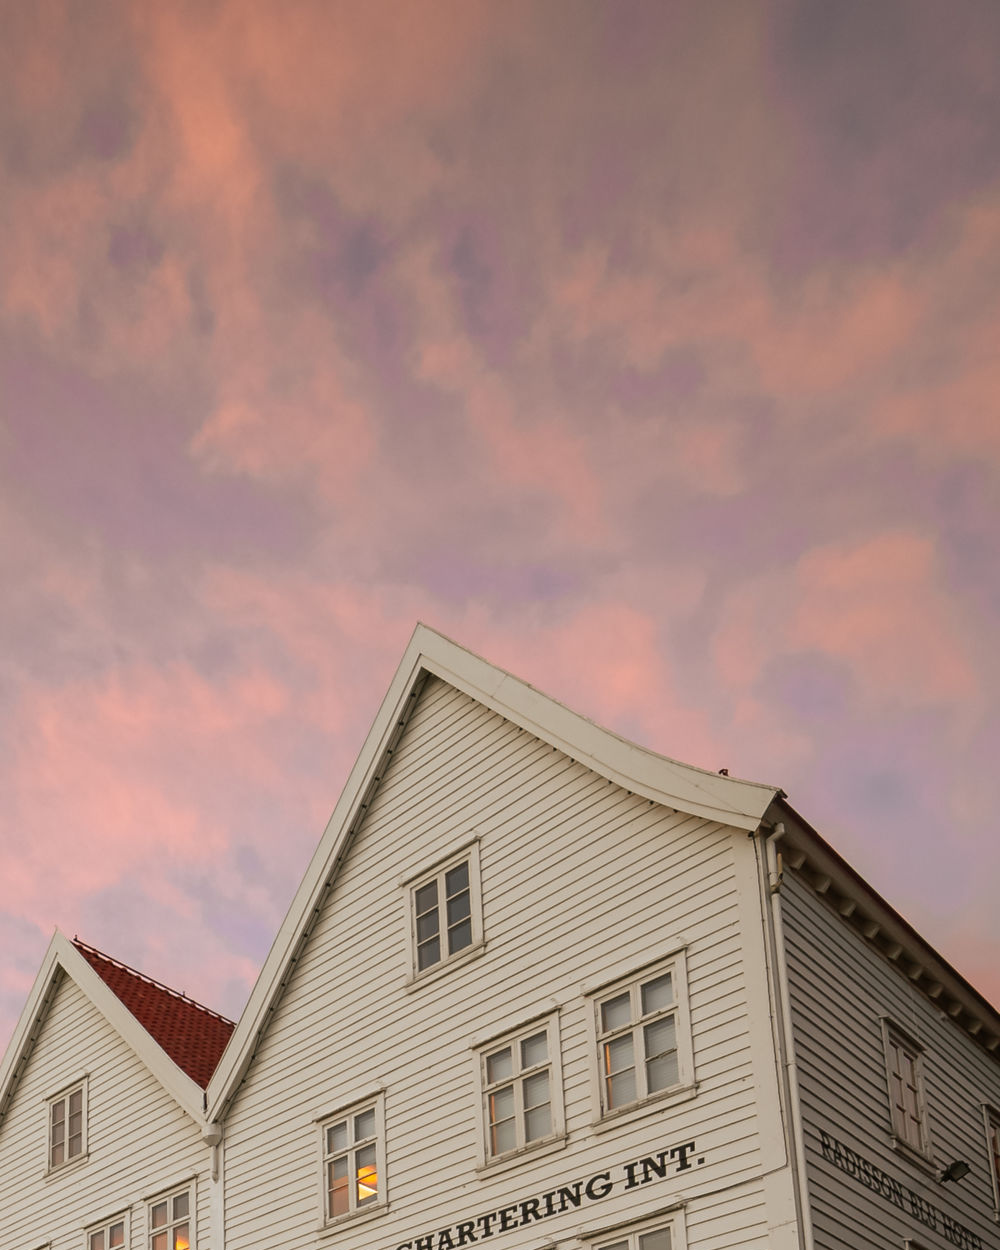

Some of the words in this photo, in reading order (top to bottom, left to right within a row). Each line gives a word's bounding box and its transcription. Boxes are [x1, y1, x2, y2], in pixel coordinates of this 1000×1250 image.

[623, 1141, 706, 1191] INT.
[819, 1129, 905, 1210] RADISSON
[908, 1190, 937, 1231] BLU
